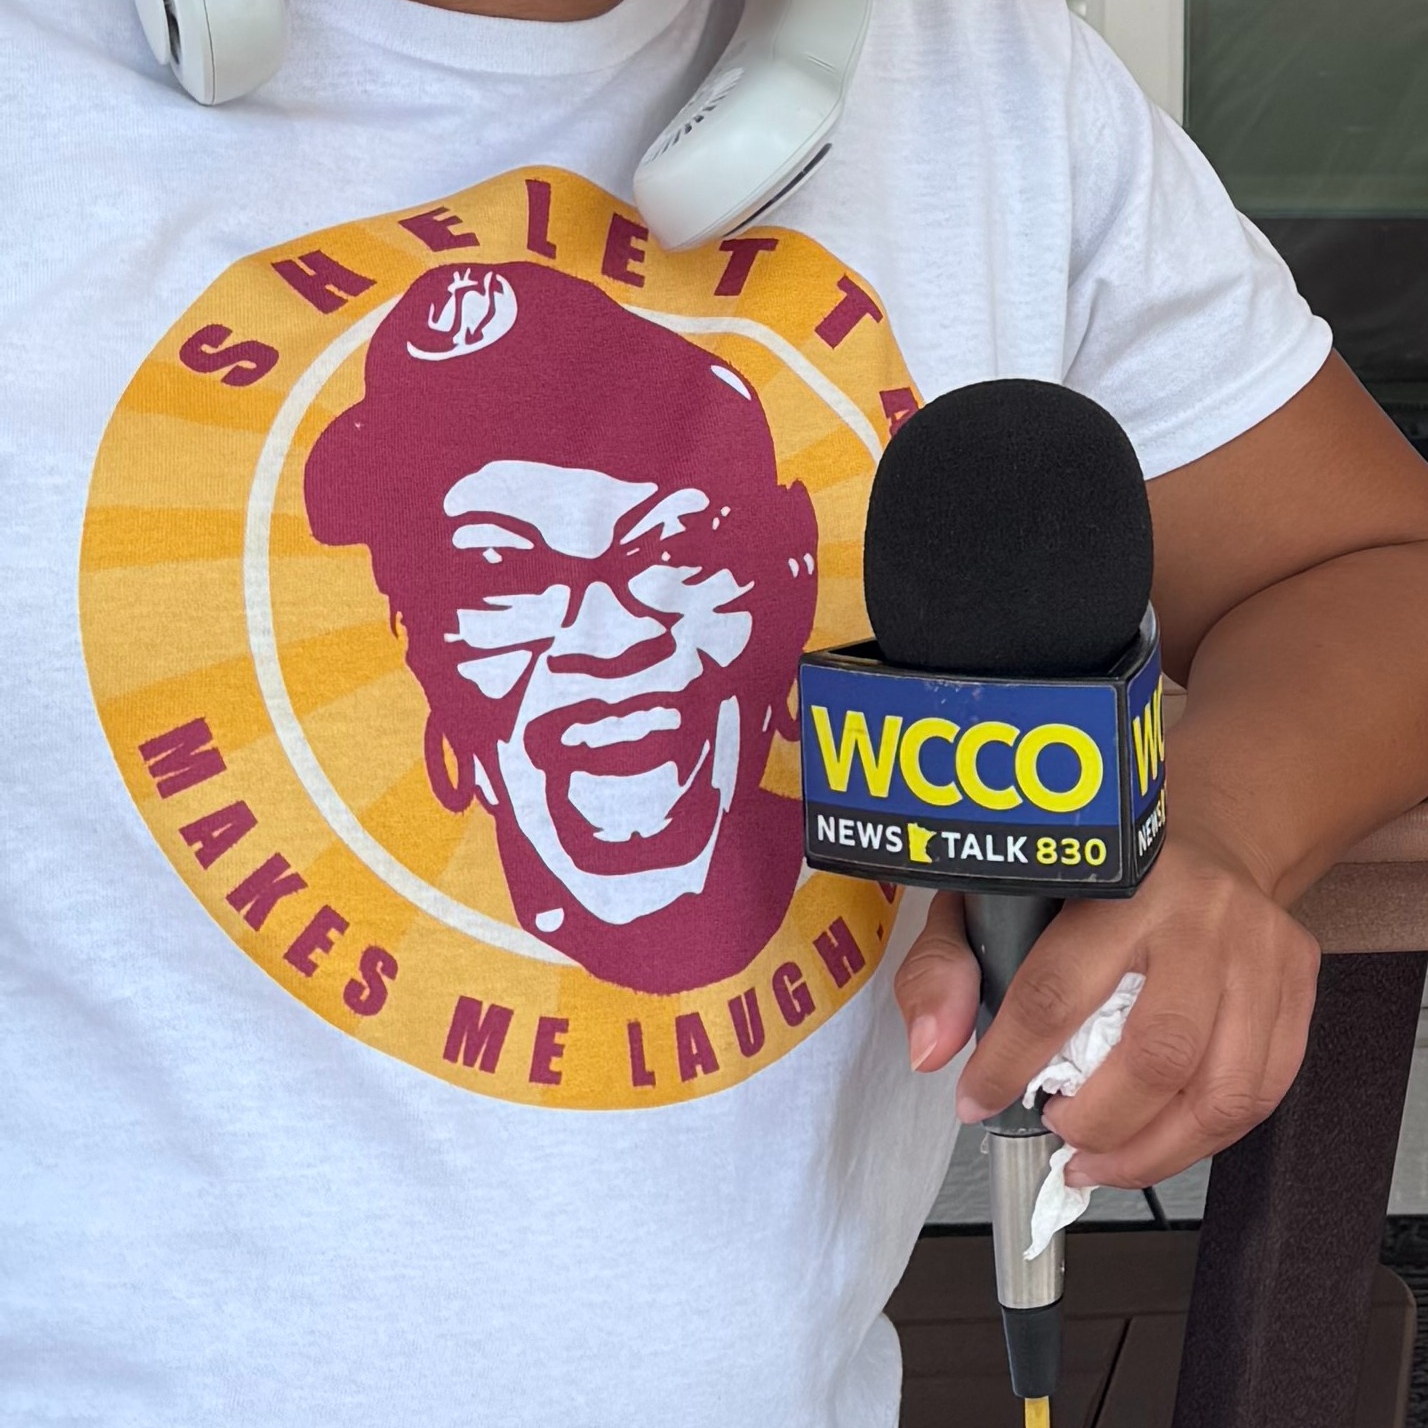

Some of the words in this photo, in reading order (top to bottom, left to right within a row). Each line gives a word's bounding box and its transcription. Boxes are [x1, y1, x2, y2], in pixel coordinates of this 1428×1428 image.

[811, 704, 1104, 813] WCCO
[817, 814, 903, 853] NEWS
[942, 831, 1028, 864] TALK
[1035, 837, 1107, 866] 830
[138, 716, 399, 1017] MAKES
[443, 995, 570, 1086] ME
[626, 881, 898, 1089] LAUGH.
